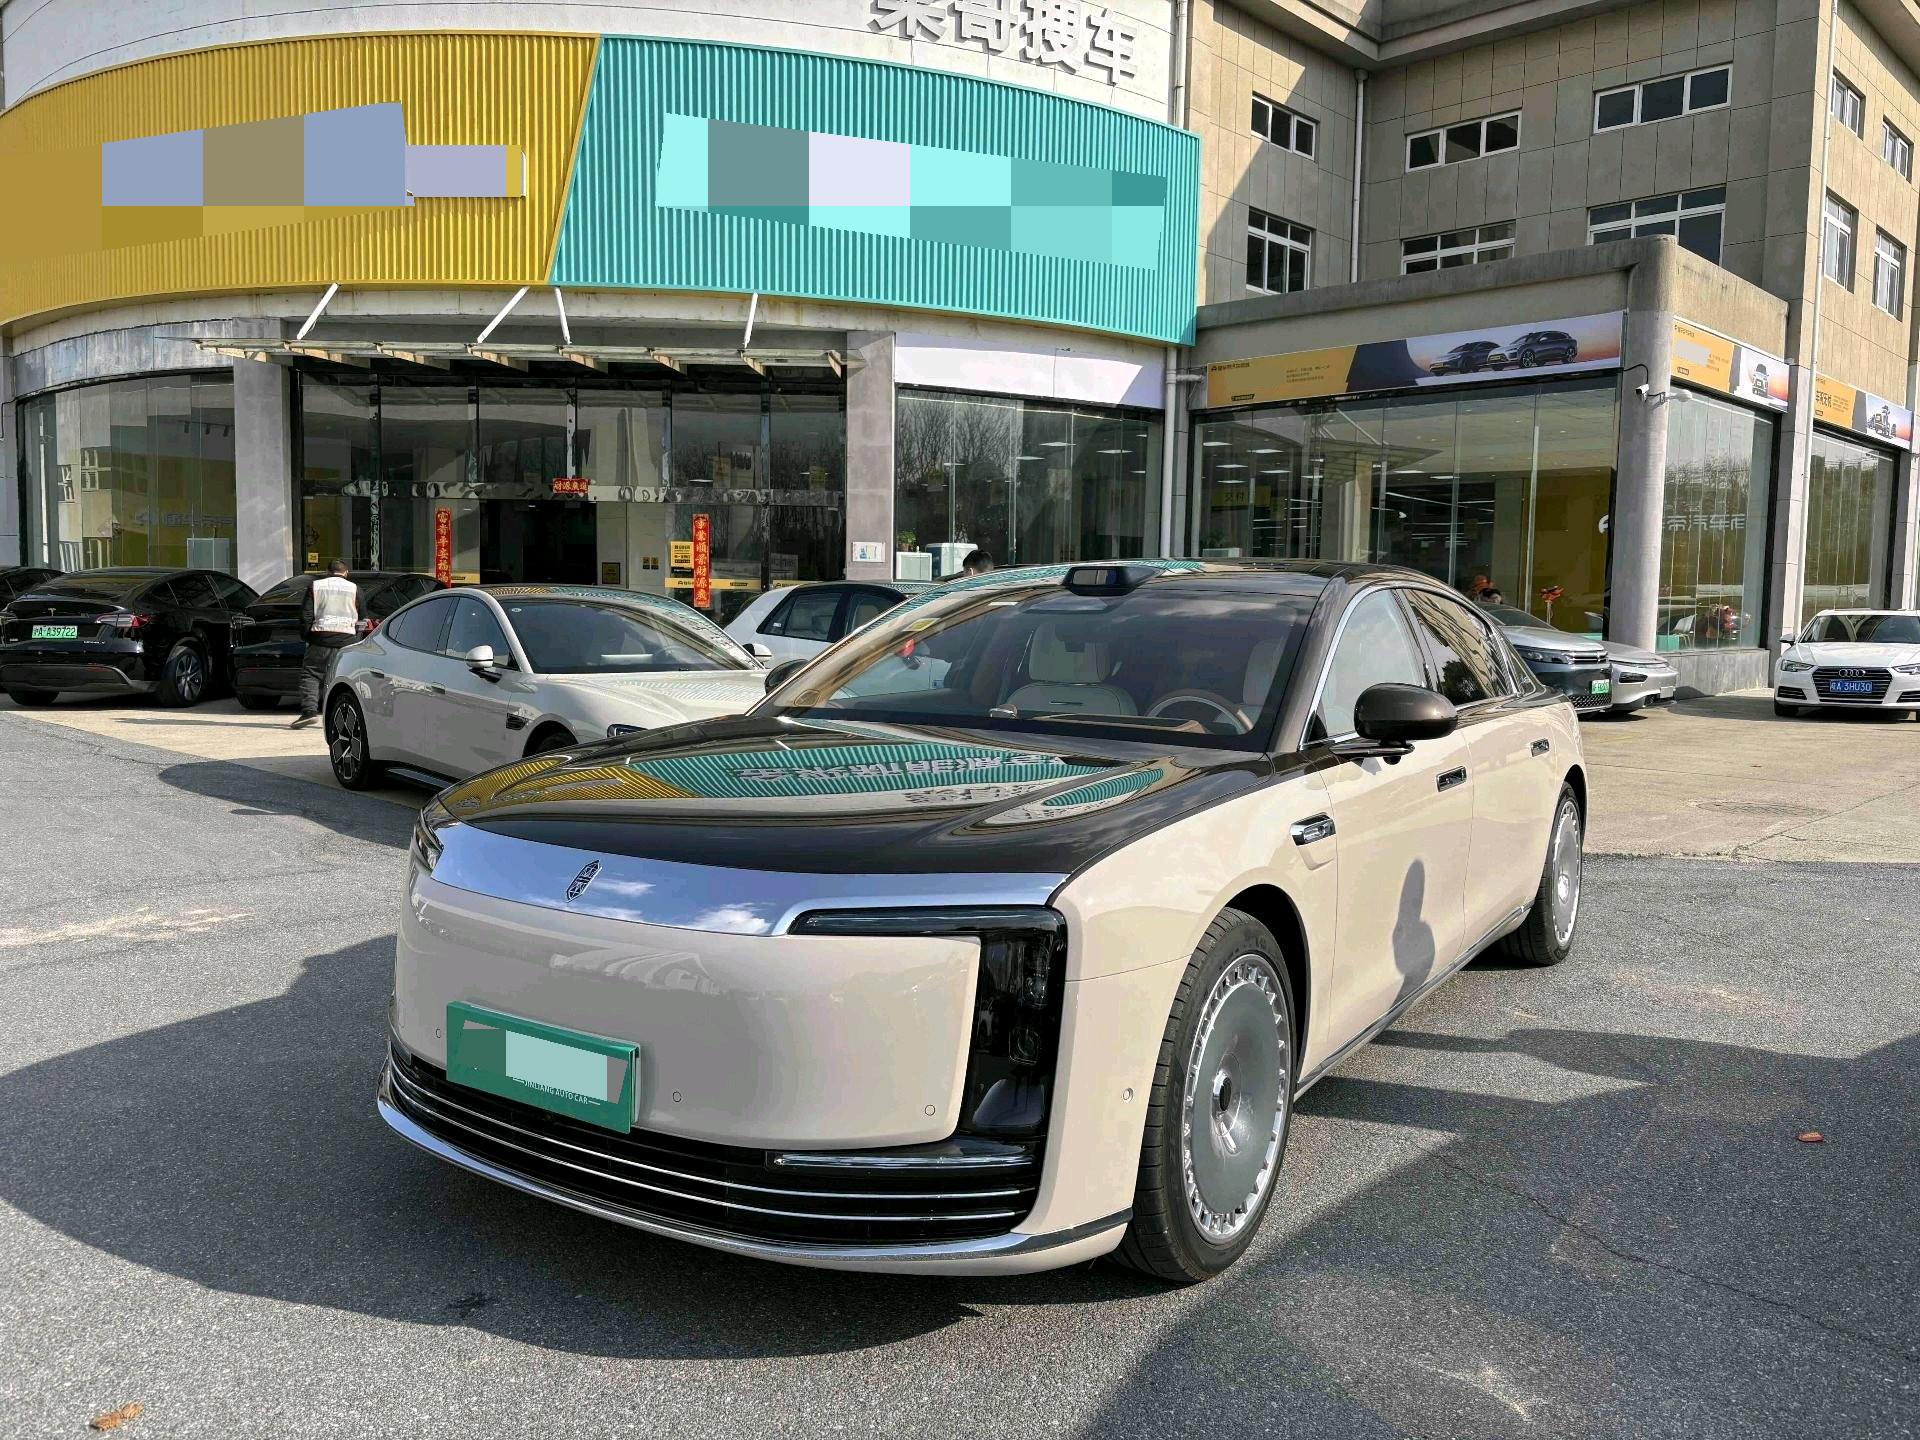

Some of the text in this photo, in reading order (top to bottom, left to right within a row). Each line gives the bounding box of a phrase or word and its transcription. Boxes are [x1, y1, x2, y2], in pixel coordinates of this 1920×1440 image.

[1662, 513, 1746, 532] 帝汽车
[555, 1088, 573, 1100] AUTO
[574, 1095, 588, 1105] CAR
